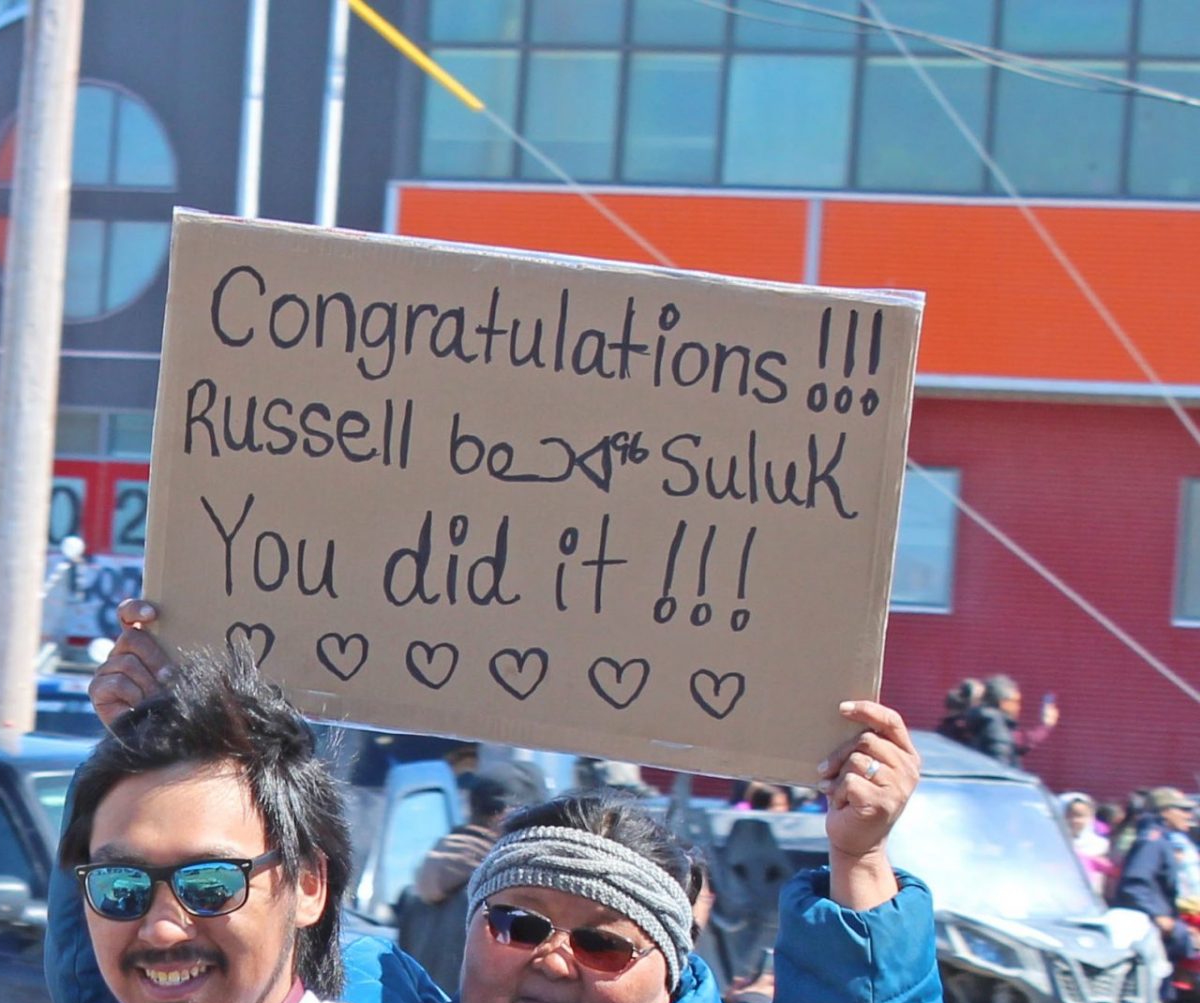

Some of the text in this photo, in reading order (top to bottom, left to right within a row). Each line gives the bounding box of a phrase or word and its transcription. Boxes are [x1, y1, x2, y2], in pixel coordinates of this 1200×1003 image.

[182, 377, 414, 471] Russell
[199, 491, 340, 601] You
[381, 509, 522, 608] did
